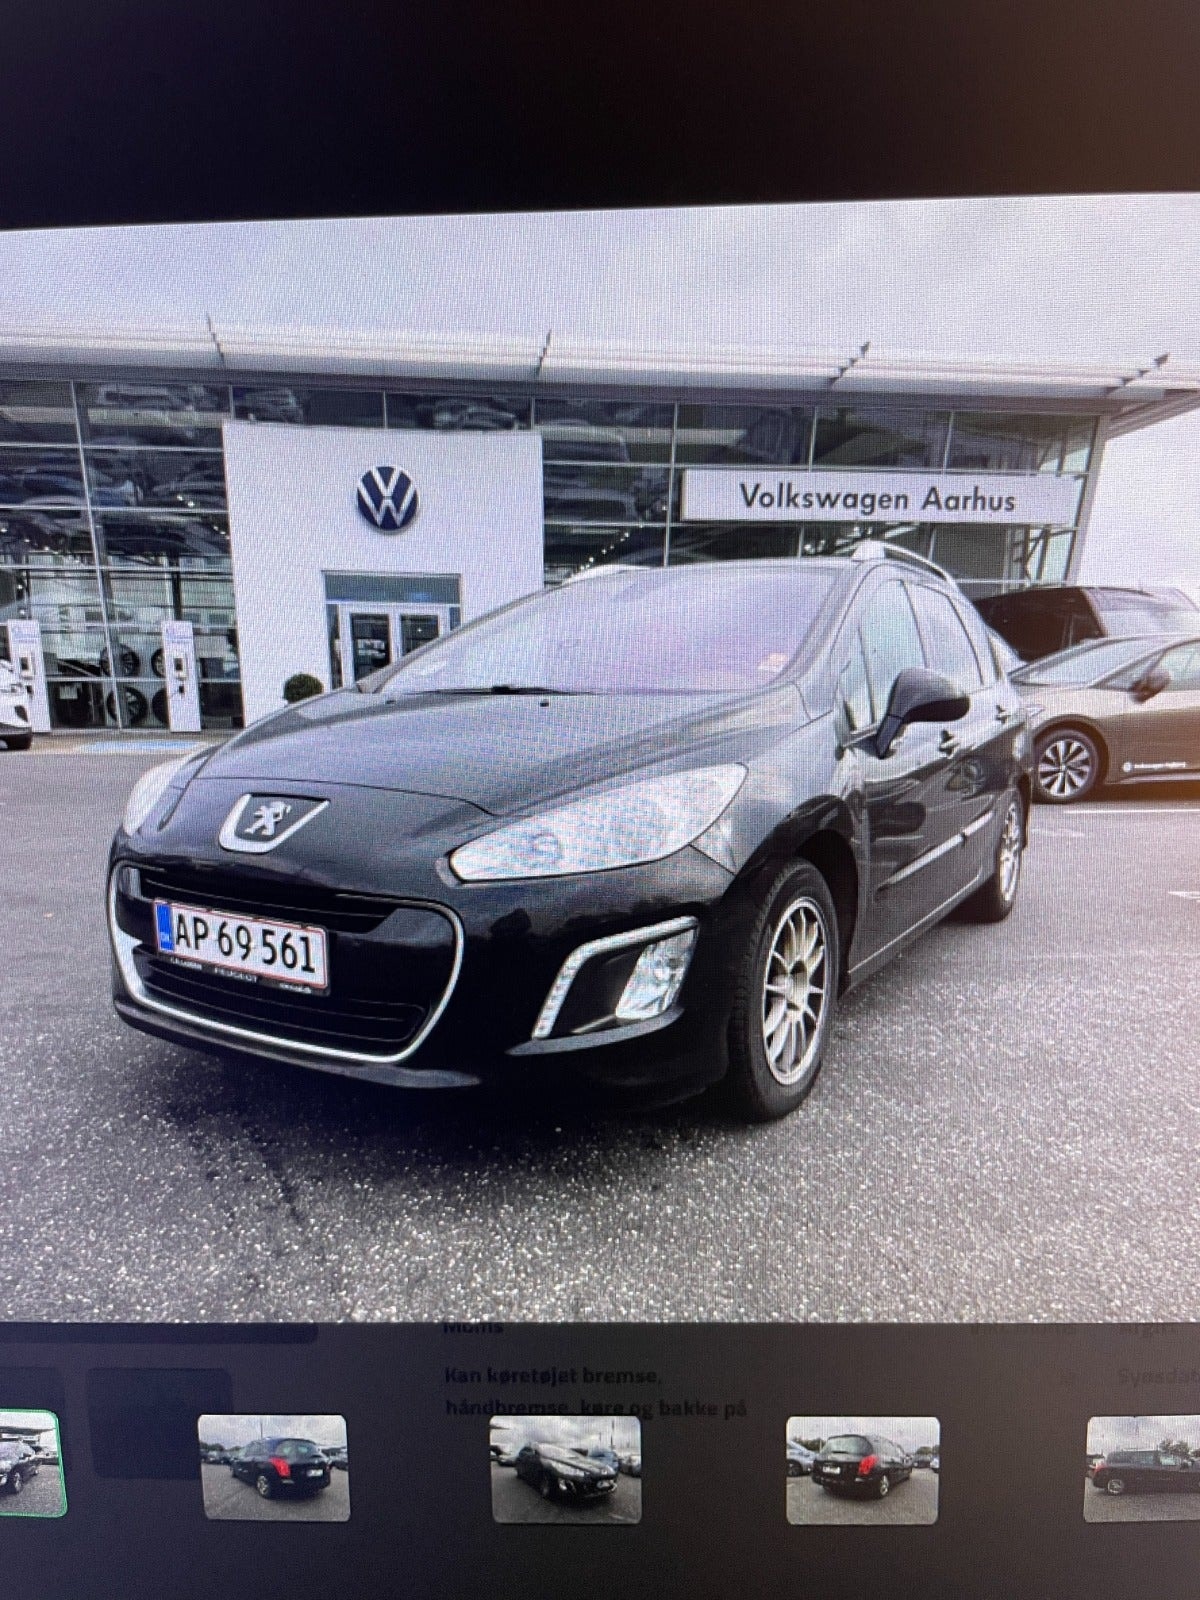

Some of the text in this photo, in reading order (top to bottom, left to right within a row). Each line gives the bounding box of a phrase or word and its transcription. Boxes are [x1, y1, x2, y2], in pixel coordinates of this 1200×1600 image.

[739, 482, 1017, 516] Volkswagen Aarhus
[175, 913, 316, 974] AP 69 561
[445, 1366, 662, 1388] Kan køretøjet bremse,
[630, 1402, 654, 1420] og
[659, 1399, 719, 1417] bakke
[725, 1400, 749, 1420] på
